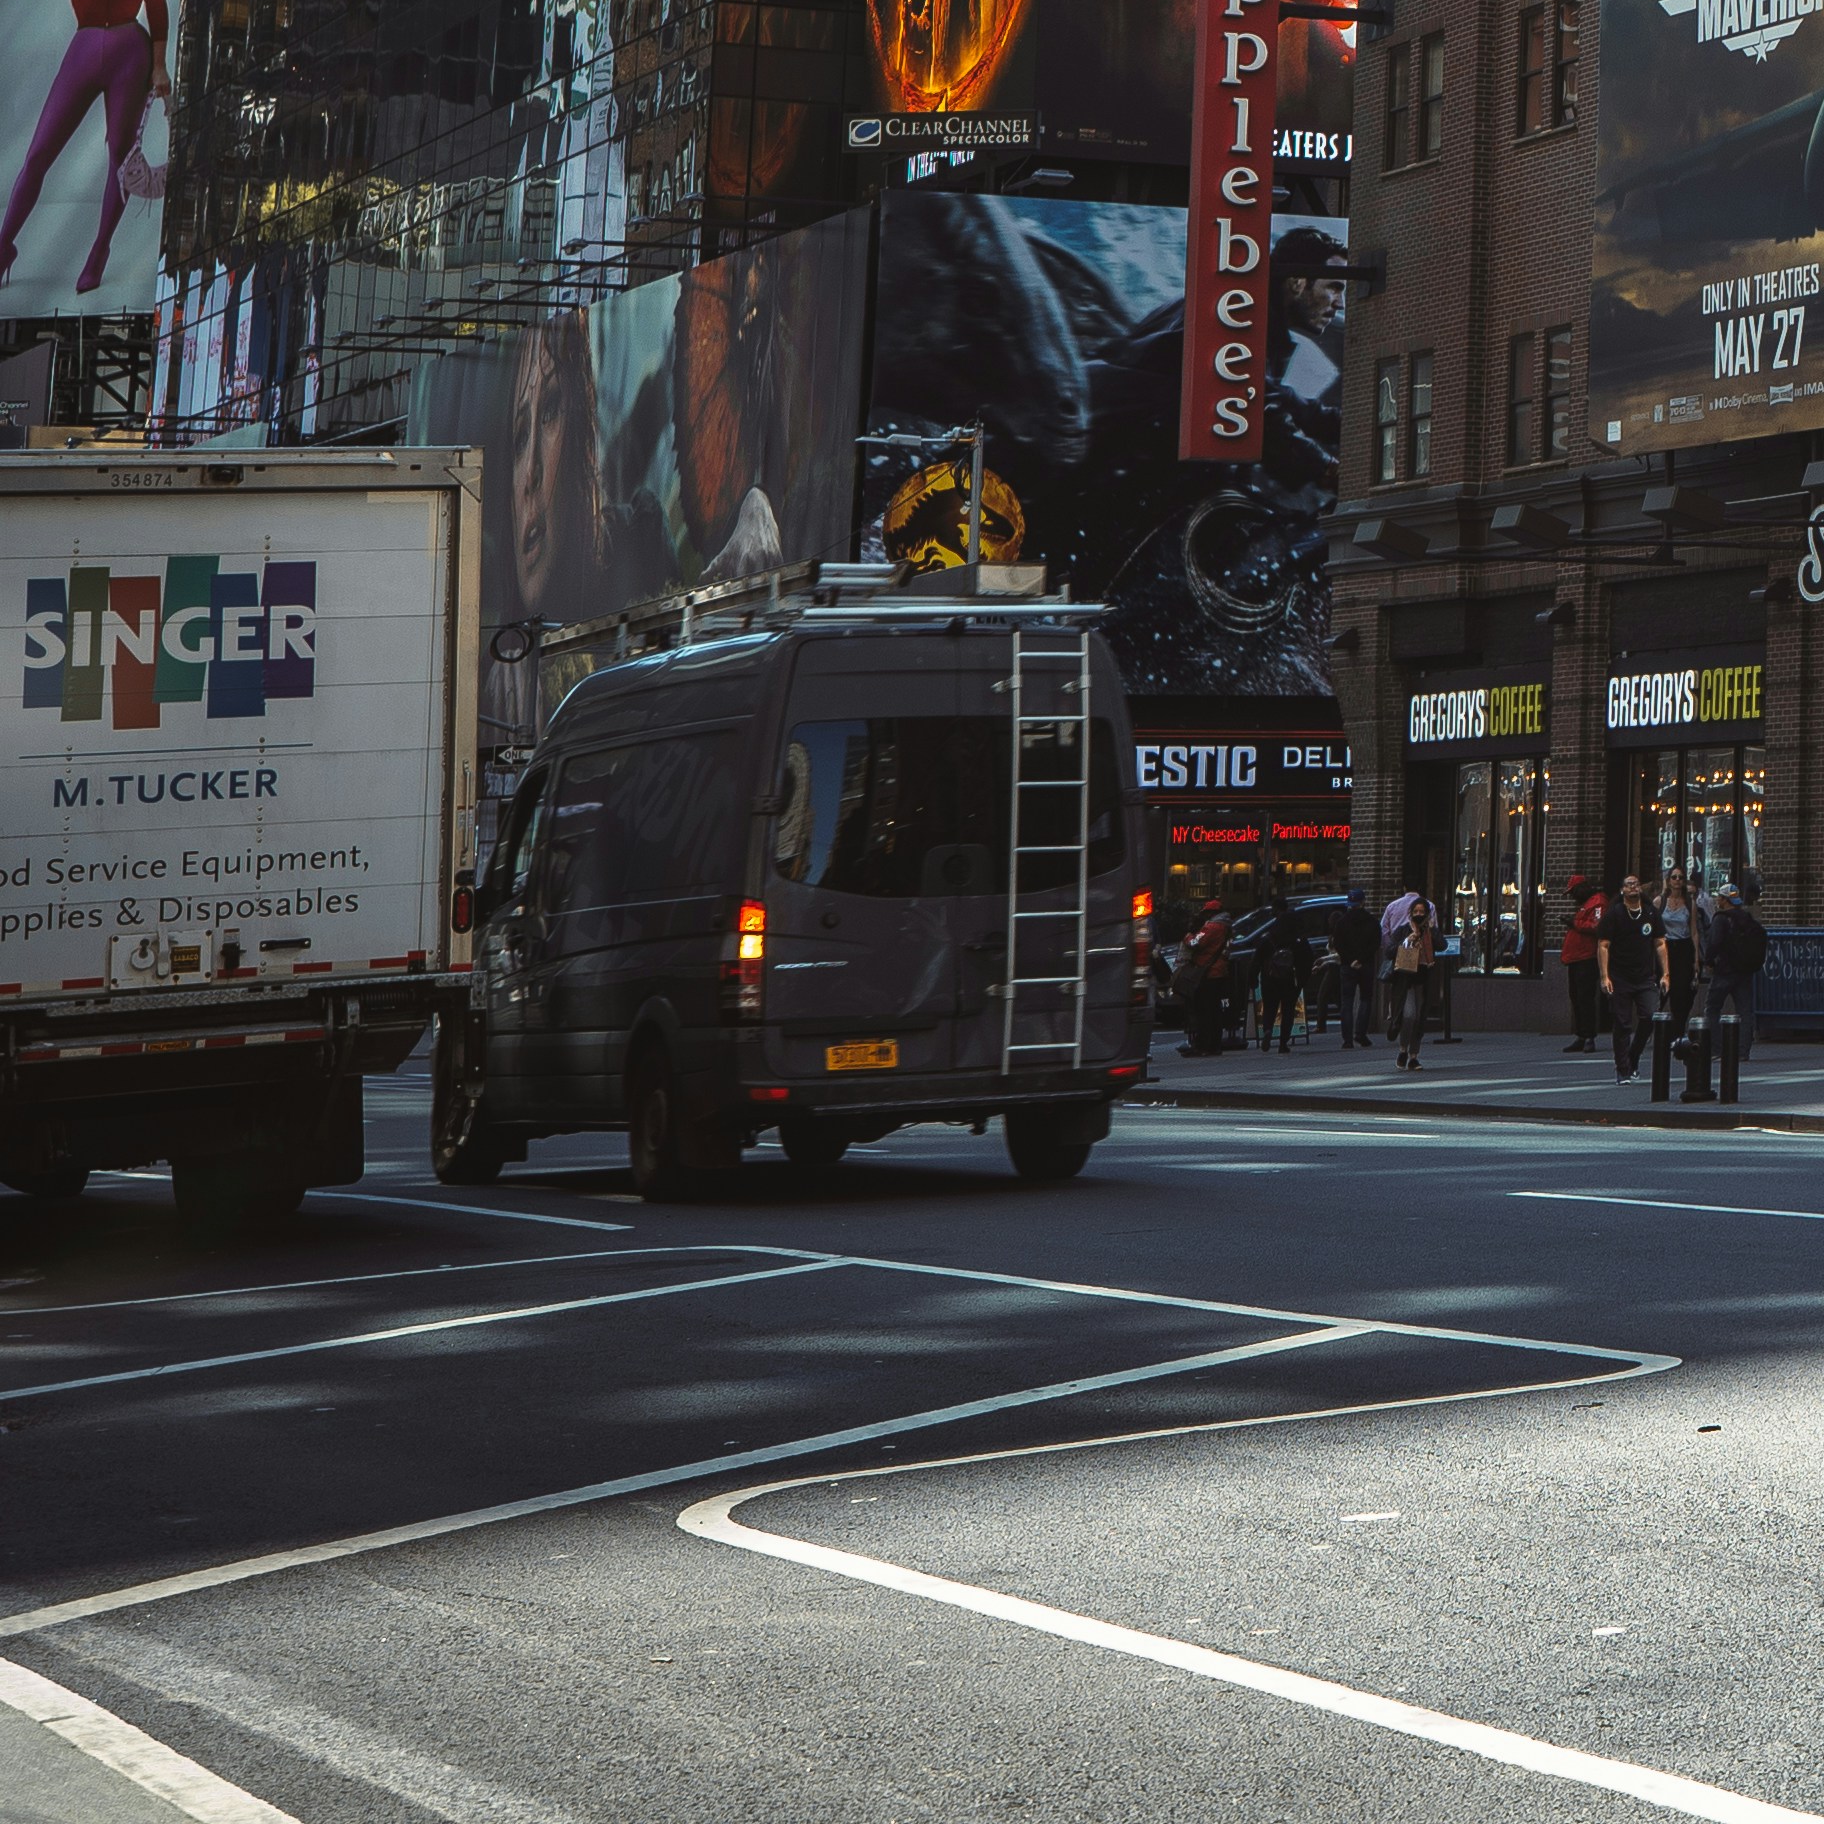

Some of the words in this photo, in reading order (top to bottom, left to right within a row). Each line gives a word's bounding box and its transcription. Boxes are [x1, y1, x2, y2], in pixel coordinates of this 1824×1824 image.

[943, 134, 1030, 145] SPECTACOLOR
[1702, 283, 1733, 315] ONLY
[1738, 278, 1750, 305] IN
[1754, 264, 1819, 303] THEATRES
[1714, 314, 1765, 379] MAY
[1773, 306, 1805, 369] 27
[111, 473, 173, 488] 354874
[23, 606, 316, 668] SINGER
[1409, 690, 1487, 744] GREGORYS
[1489, 684, 1544, 735] COFFEE
[1608, 669, 1695, 729] GREGORYS
[1699, 665, 1762, 721] COFFEE
[1173, 826, 1188, 843] NY
[1191, 825, 1259, 842] Cheesecake
[46, 854, 167, 885] Service
[182, 844, 370, 879] Equipment,
[117, 898, 144, 926] &
[159, 887, 359, 923] Disposables
